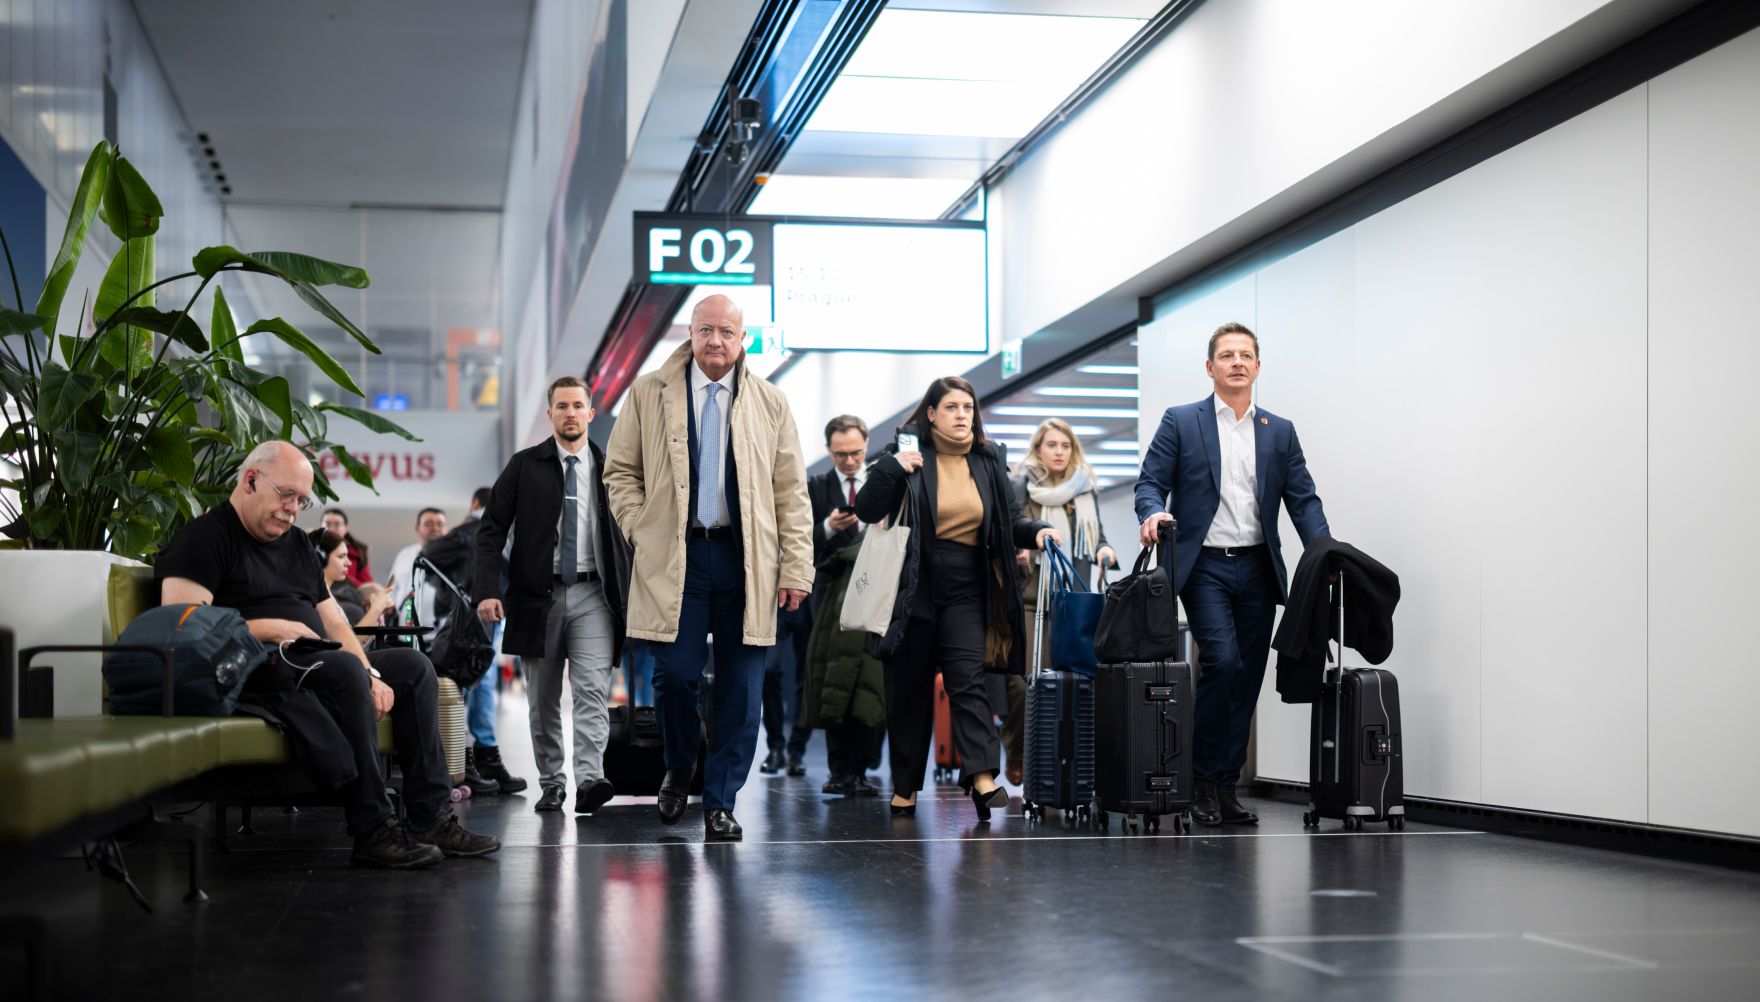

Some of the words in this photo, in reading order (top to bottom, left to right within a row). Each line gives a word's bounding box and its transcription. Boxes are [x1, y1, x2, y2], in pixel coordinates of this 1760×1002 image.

[649, 227, 682, 272] F
[689, 228, 756, 274] 02
[307, 444, 435, 481] evus
